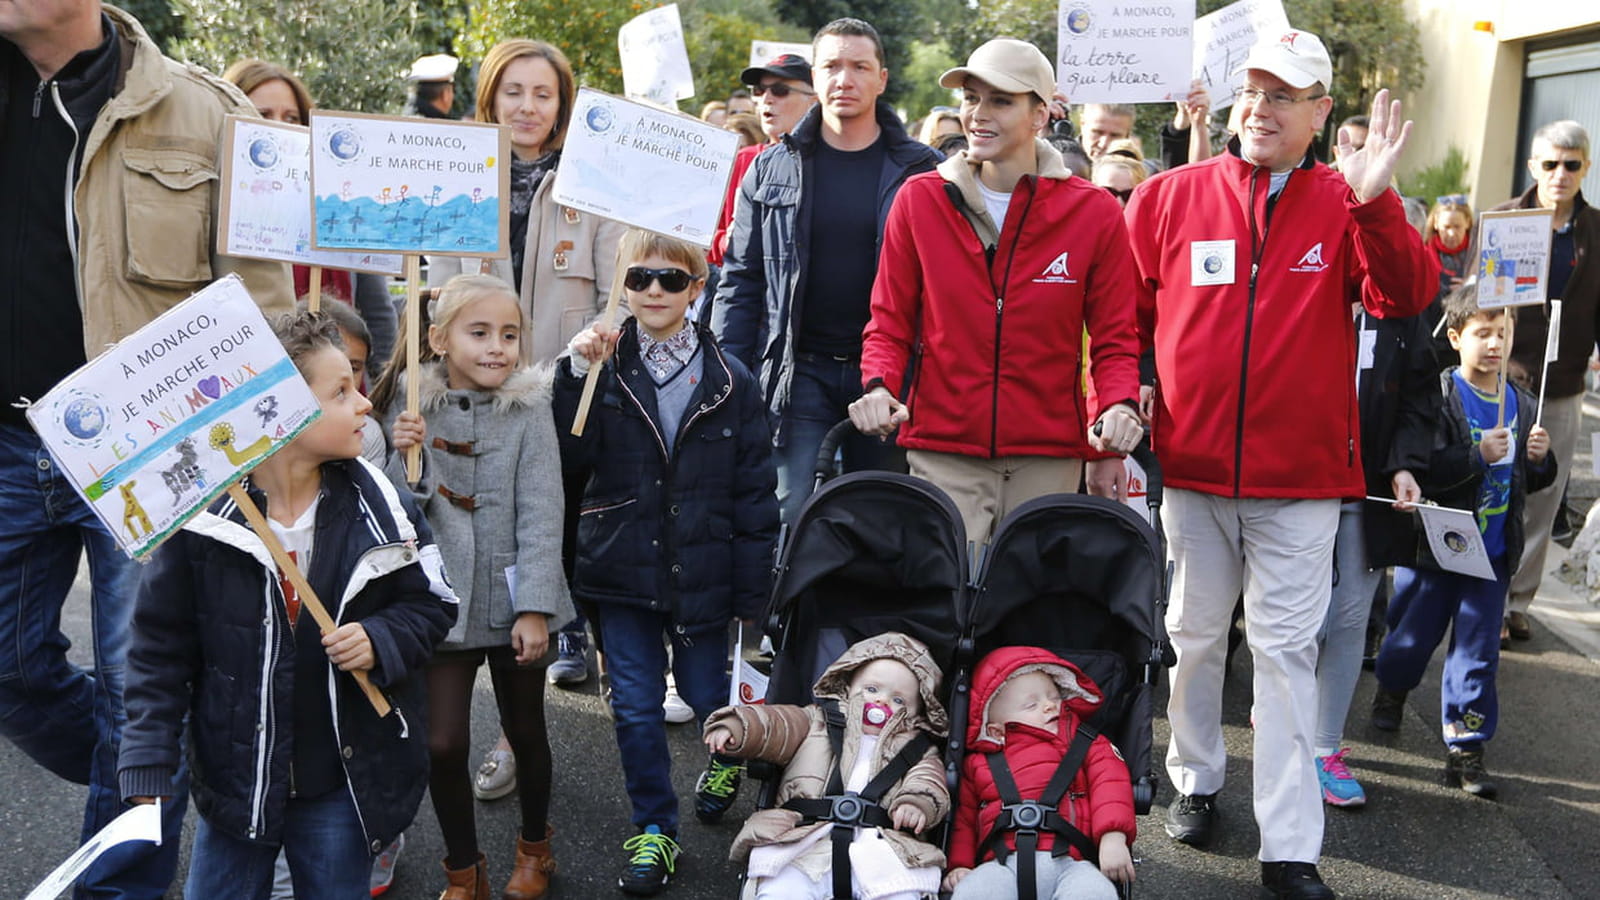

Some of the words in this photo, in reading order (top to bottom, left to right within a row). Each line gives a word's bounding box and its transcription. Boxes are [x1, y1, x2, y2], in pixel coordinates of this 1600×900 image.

[1096, 28, 1108, 39] JE
[1112, 27, 1157, 38] MARCHE
[1161, 26, 1190, 37] POUR
[1061, 44, 1082, 67] la
[1084, 46, 1142, 67] terre
[1067, 69, 1097, 96] qui
[1100, 66, 1167, 92] pleure
[387, 132, 396, 145] À
[402, 134, 466, 150] MONACO,
[649, 120, 706, 148] MONACO,
[368, 156, 382, 168] JE
[388, 158, 443, 172] MARCHE
[449, 160, 485, 174] POUR
[615, 134, 629, 146] JE
[631, 138, 681, 162] MARCHE
[685, 153, 719, 173] POUR
[285, 168, 298, 180] JE
[120, 362, 136, 379] À
[136, 314, 218, 368] MONACO,
[121, 402, 140, 422] JE
[140, 355, 209, 407] MARCHE
[209, 325, 254, 361] POUR
[87, 432, 138, 478] LES
